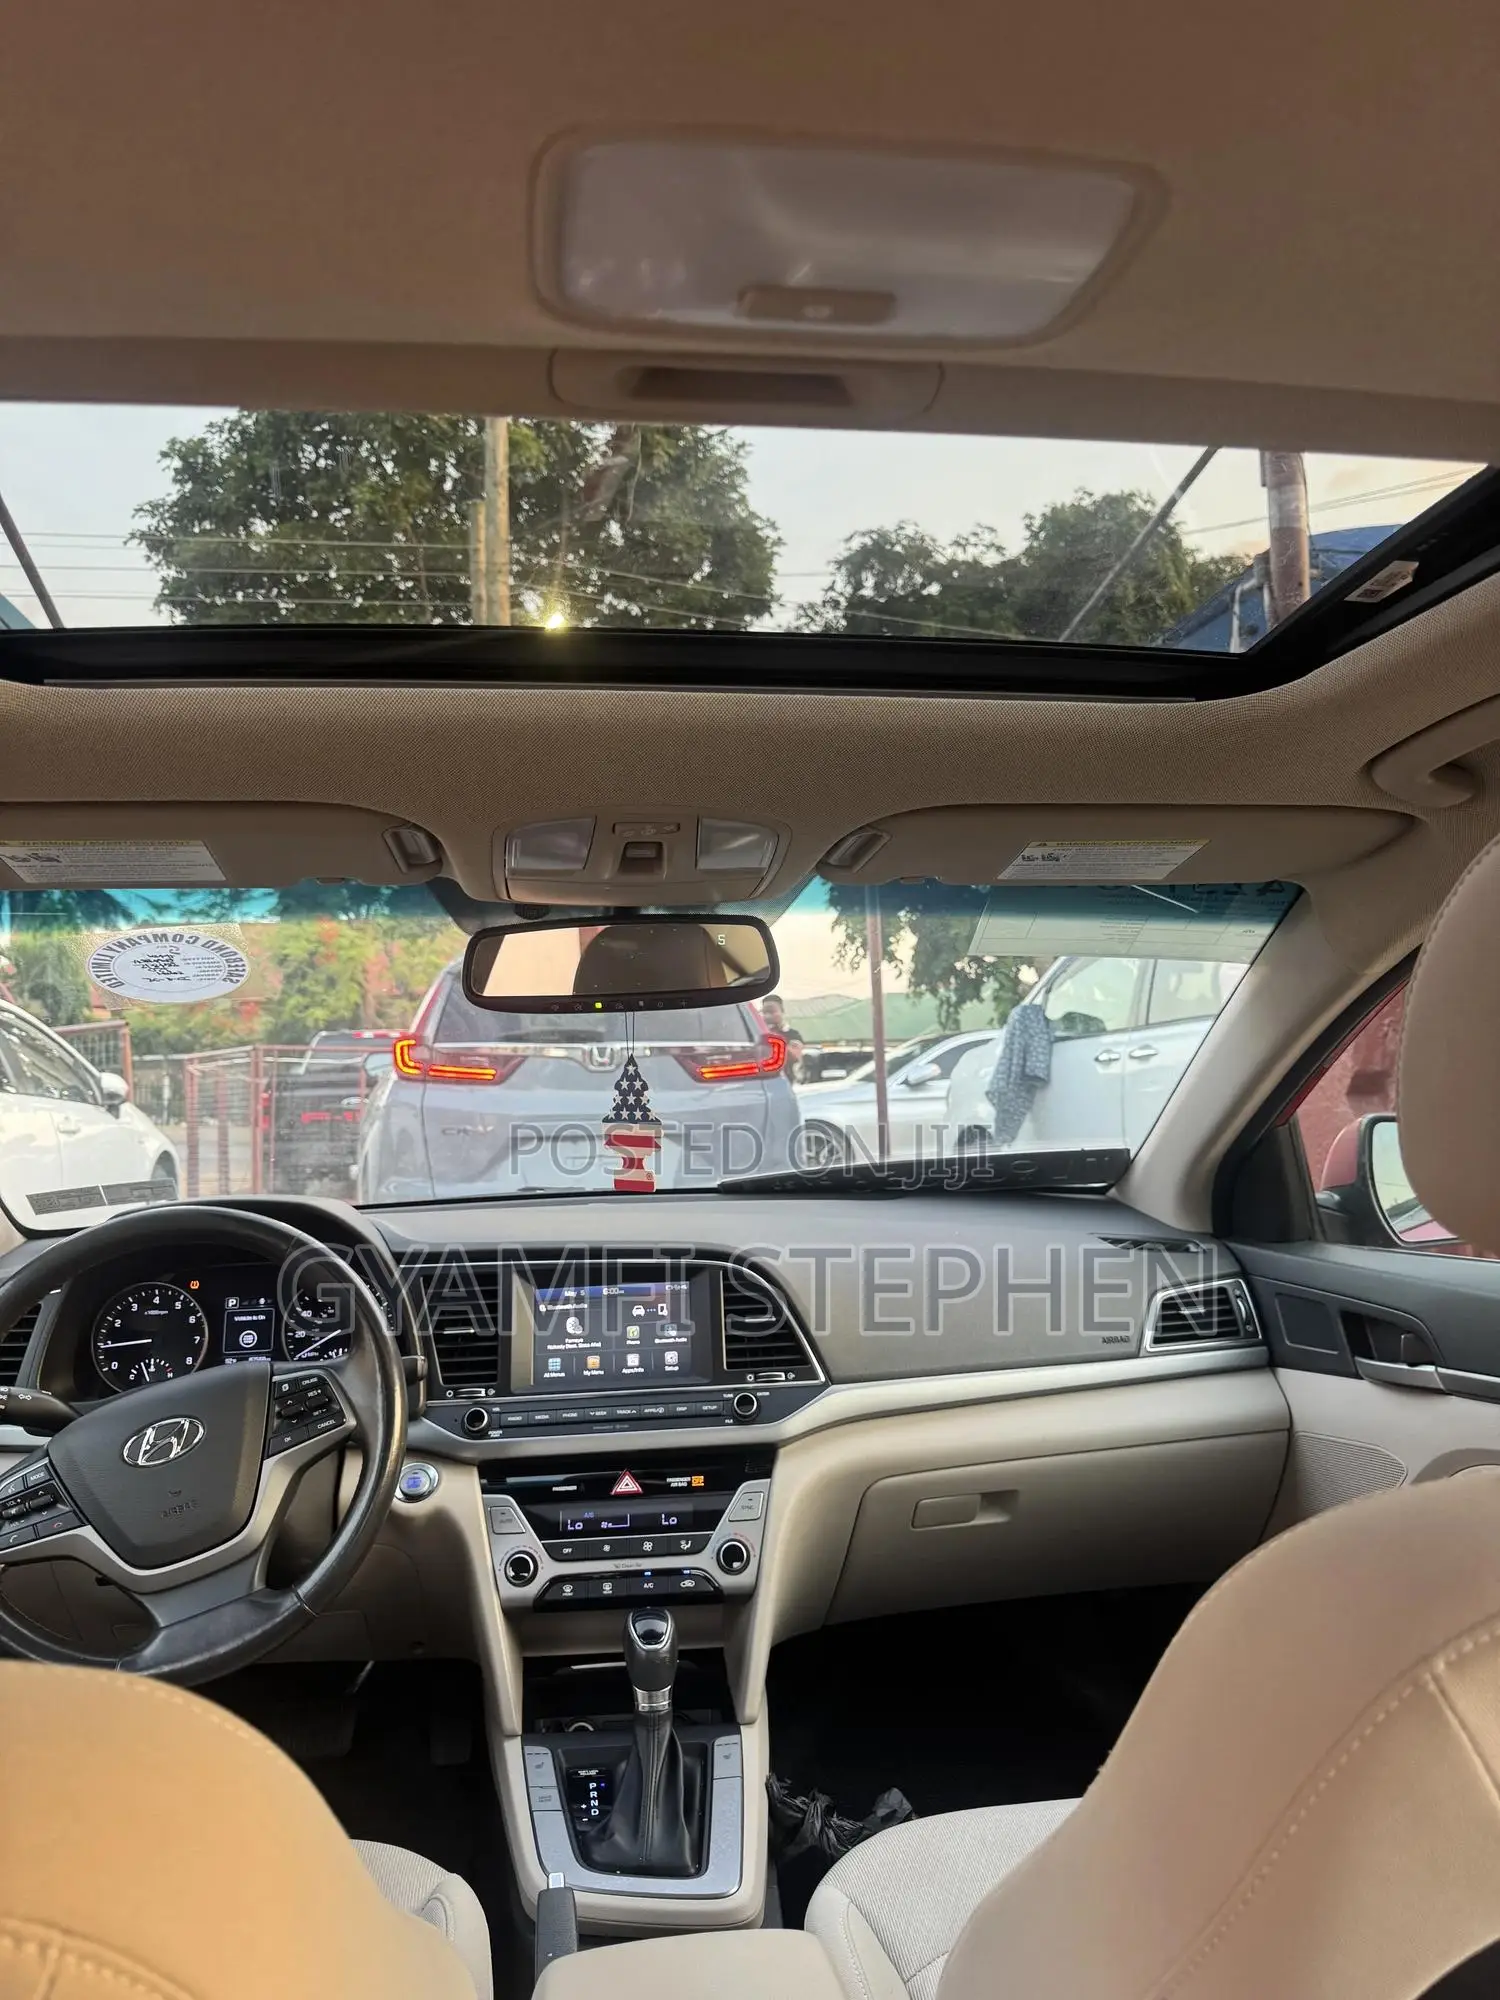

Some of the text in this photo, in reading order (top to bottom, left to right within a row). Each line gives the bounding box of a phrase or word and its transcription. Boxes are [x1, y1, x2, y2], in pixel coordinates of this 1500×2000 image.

[153, 1296, 160, 1304] 4
[131, 1303, 138, 1311] 3
[114, 1319, 121, 1327] 2
[193, 1336, 200, 1344] 7
[186, 1357, 193, 1365] 8
[661, 1513, 677, 1525] Lo
[567, 1519, 583, 1530] Lo
